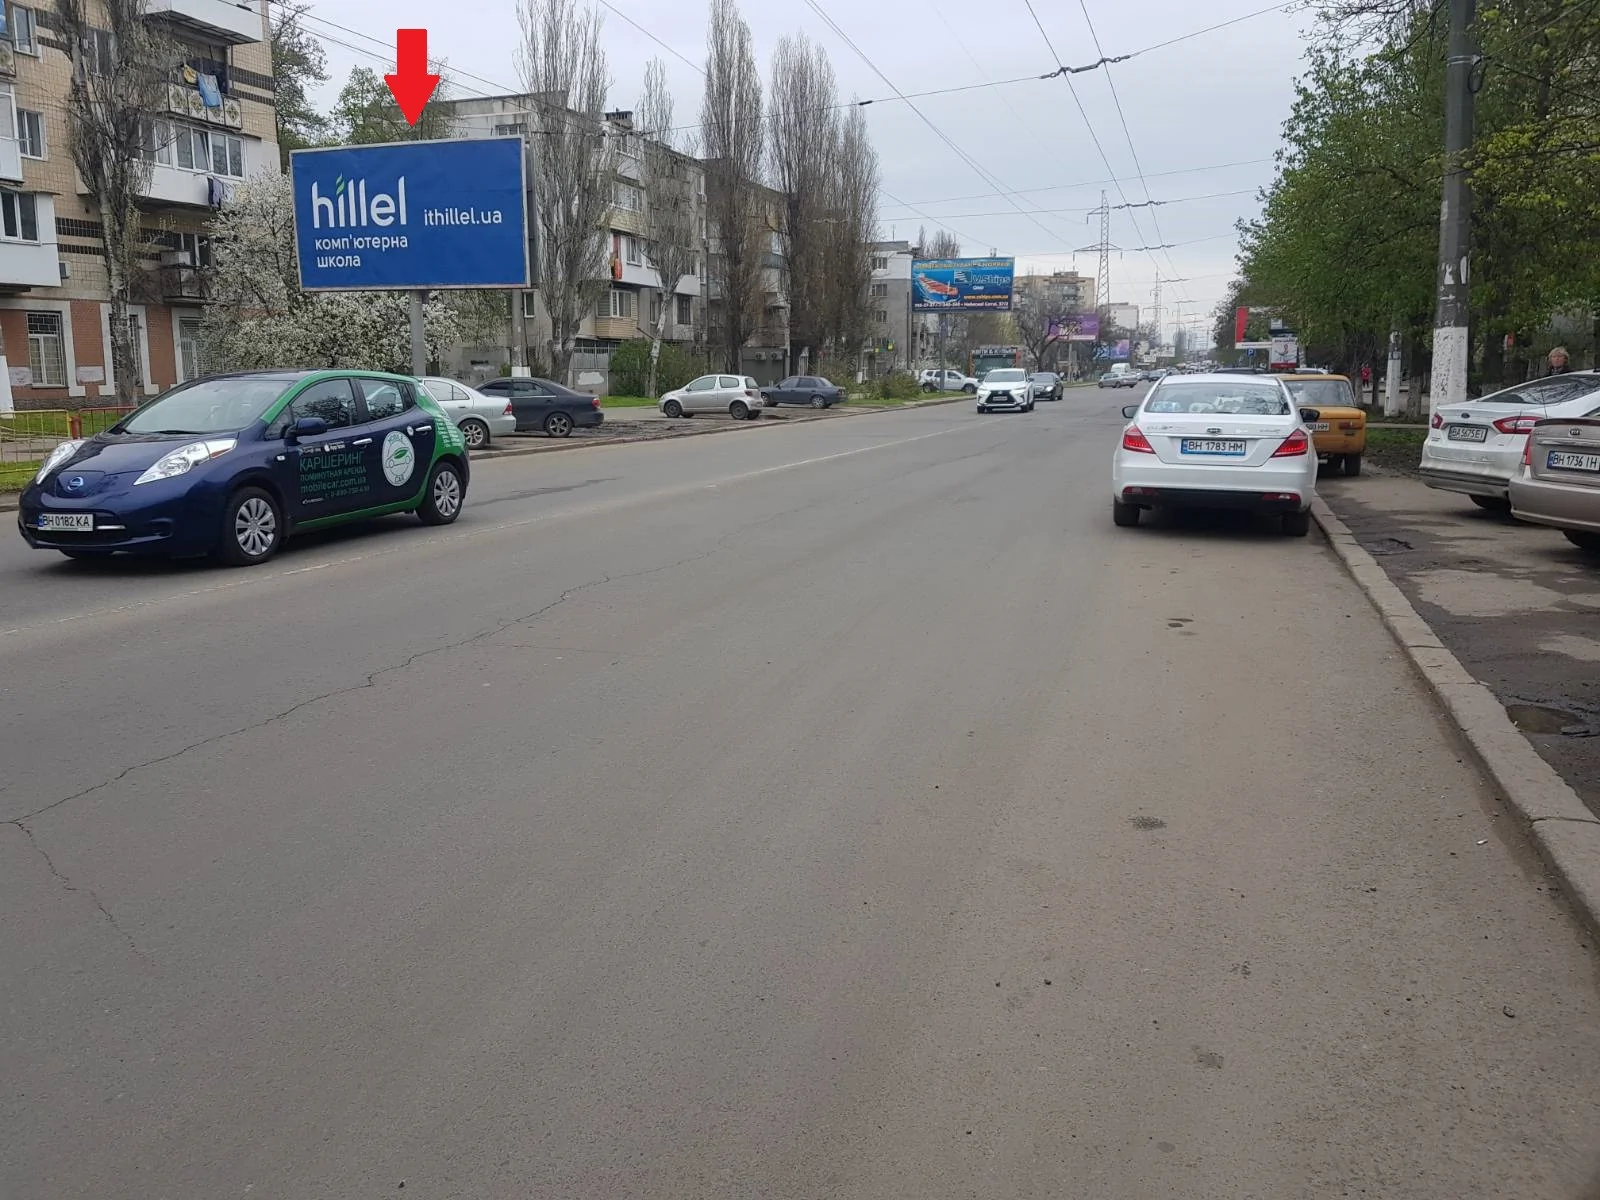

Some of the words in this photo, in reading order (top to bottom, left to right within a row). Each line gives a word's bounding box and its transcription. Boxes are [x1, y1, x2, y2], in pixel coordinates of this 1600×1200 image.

[311, 172, 407, 229] hillel
[424, 207, 502, 226] ithillel.ua
[315, 234, 408, 252] комп'ютерна
[317, 253, 361, 269] школа
[1205, 441, 1226, 451] 1783
[300, 452, 365, 472] КАРШЕРИНГ
[1567, 455, 1584, 466] 1736
[43, 515, 54, 526] BH
[55, 515, 75, 527] 0182
[76, 515, 90, 527] KA
